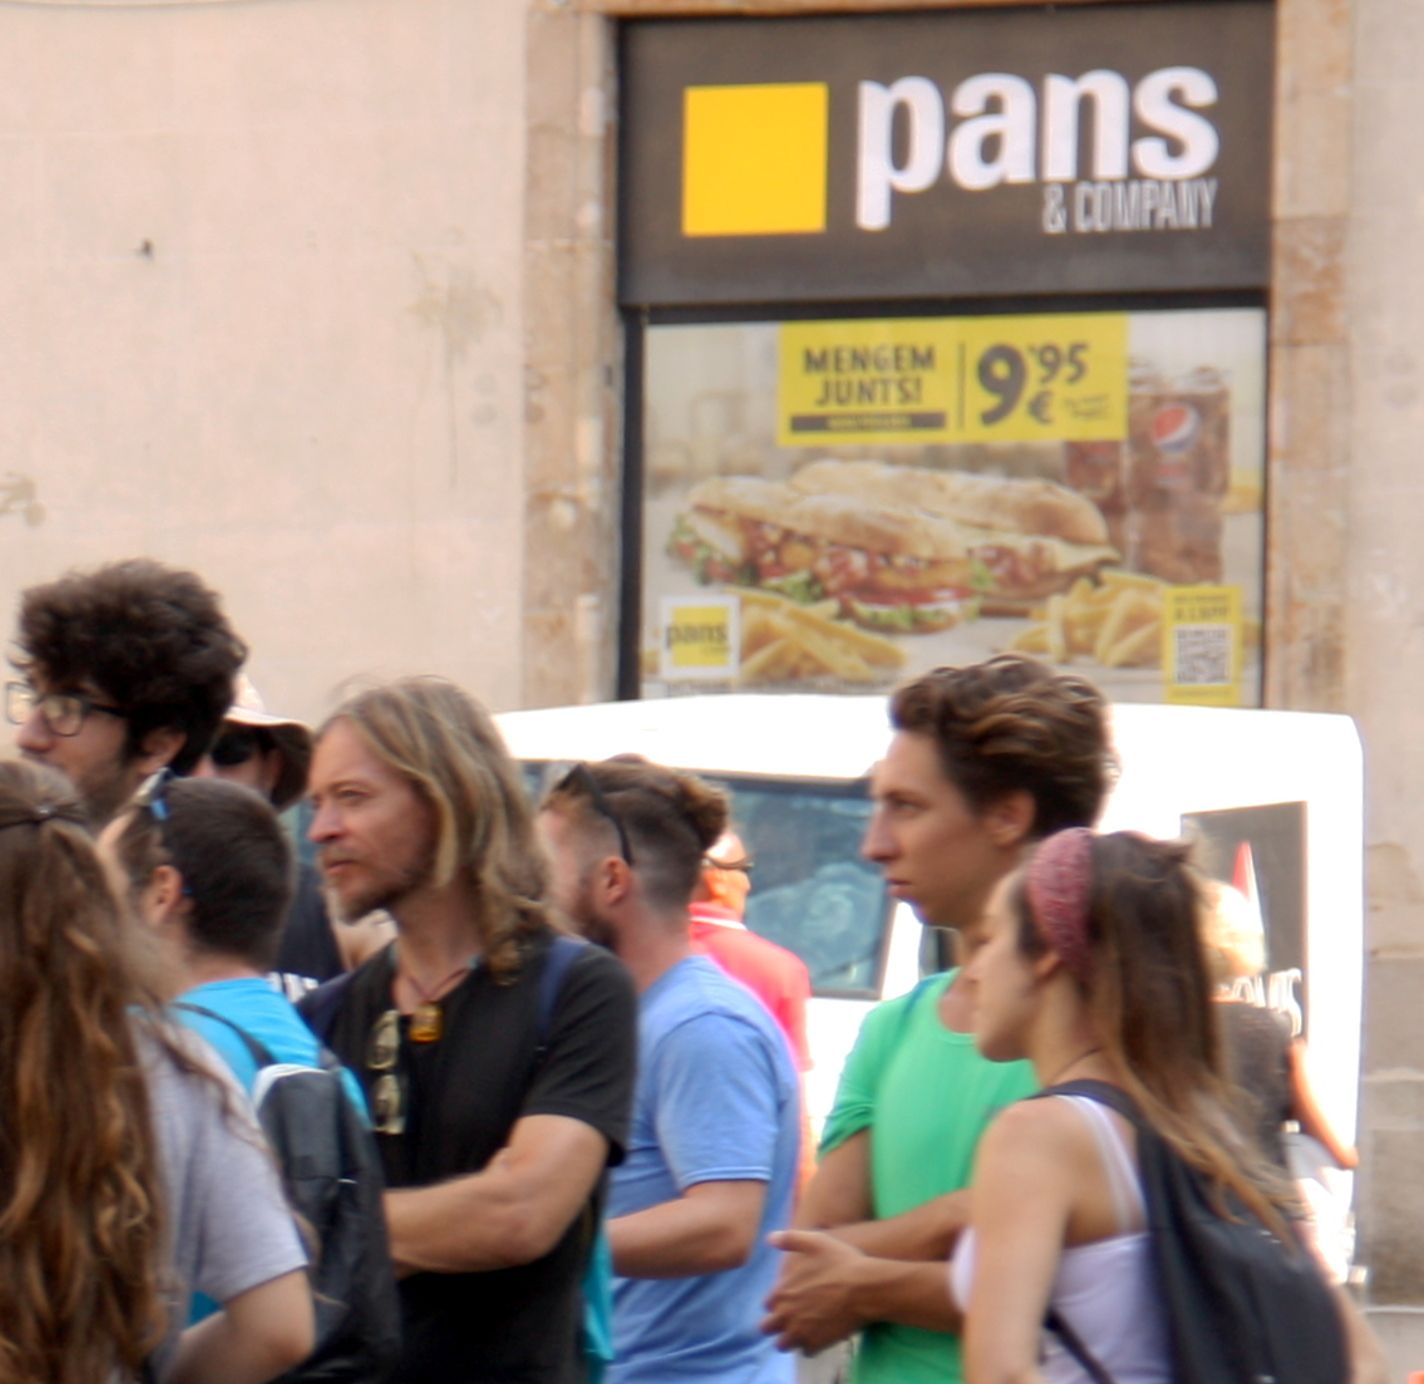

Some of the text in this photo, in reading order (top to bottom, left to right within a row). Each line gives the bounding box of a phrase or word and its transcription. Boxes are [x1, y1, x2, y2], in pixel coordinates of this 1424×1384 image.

[856, 65, 1220, 232] pans
[1043, 180, 1218, 234] & COMPANY
[803, 344, 935, 374] MENGEM
[815, 376, 923, 406] JUNTS!
